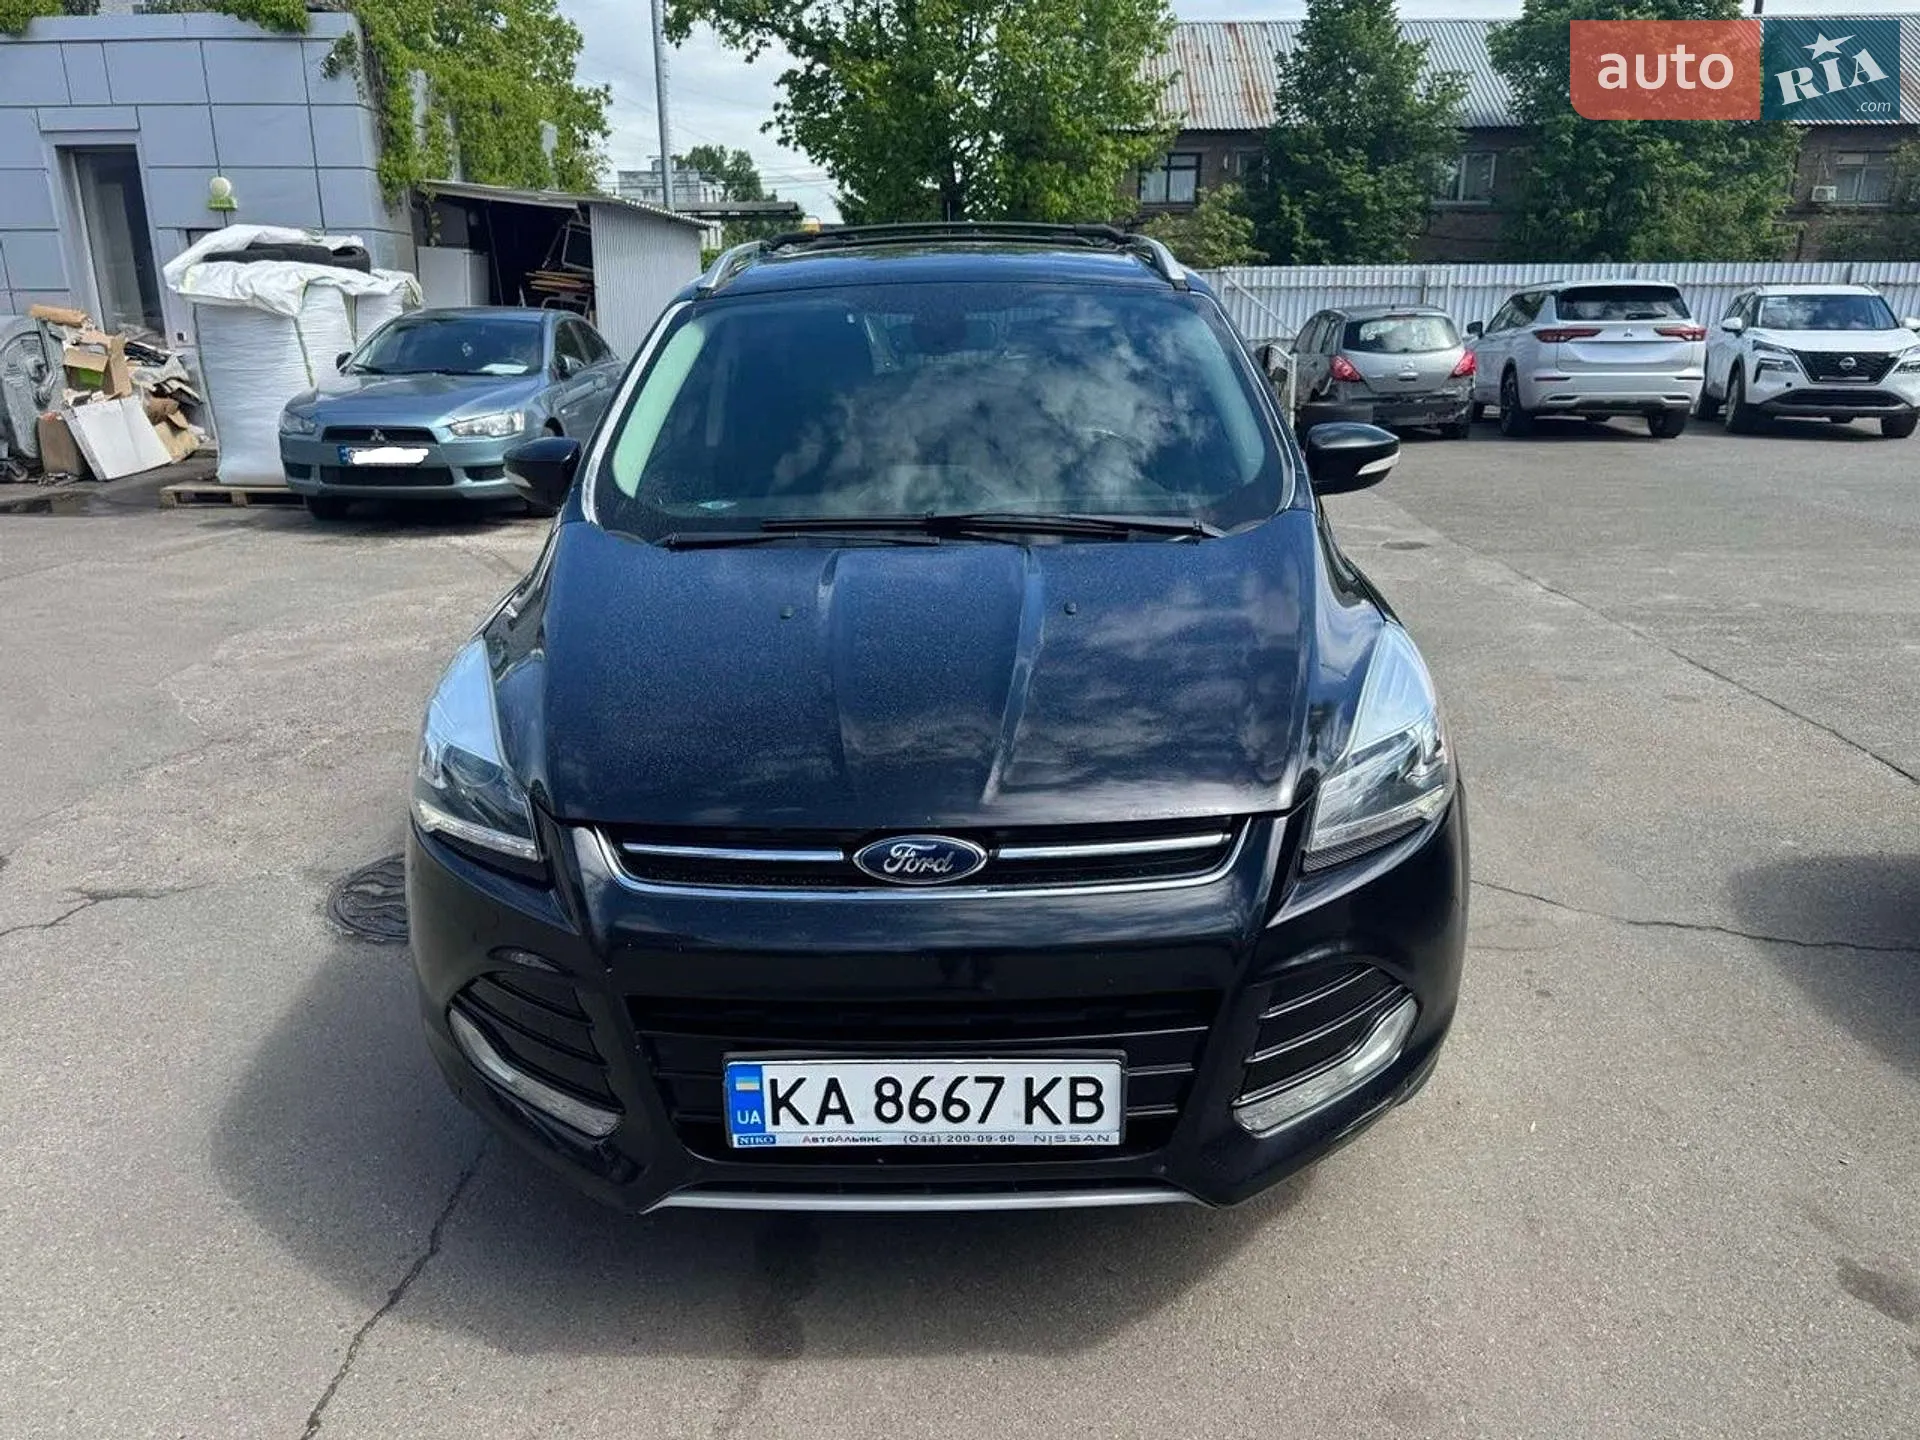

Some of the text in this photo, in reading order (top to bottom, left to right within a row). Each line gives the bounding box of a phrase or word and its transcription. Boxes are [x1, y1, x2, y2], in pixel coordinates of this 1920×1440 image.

[883, 843, 954, 873] Ford
[769, 1075, 1104, 1126] KA 8667 KB
[736, 1110, 762, 1125] UA
[738, 1135, 775, 1145] NIKO
[902, 1134, 1016, 1144] (044) 200-09-90
[1033, 1134, 1110, 1144] NISSAN
